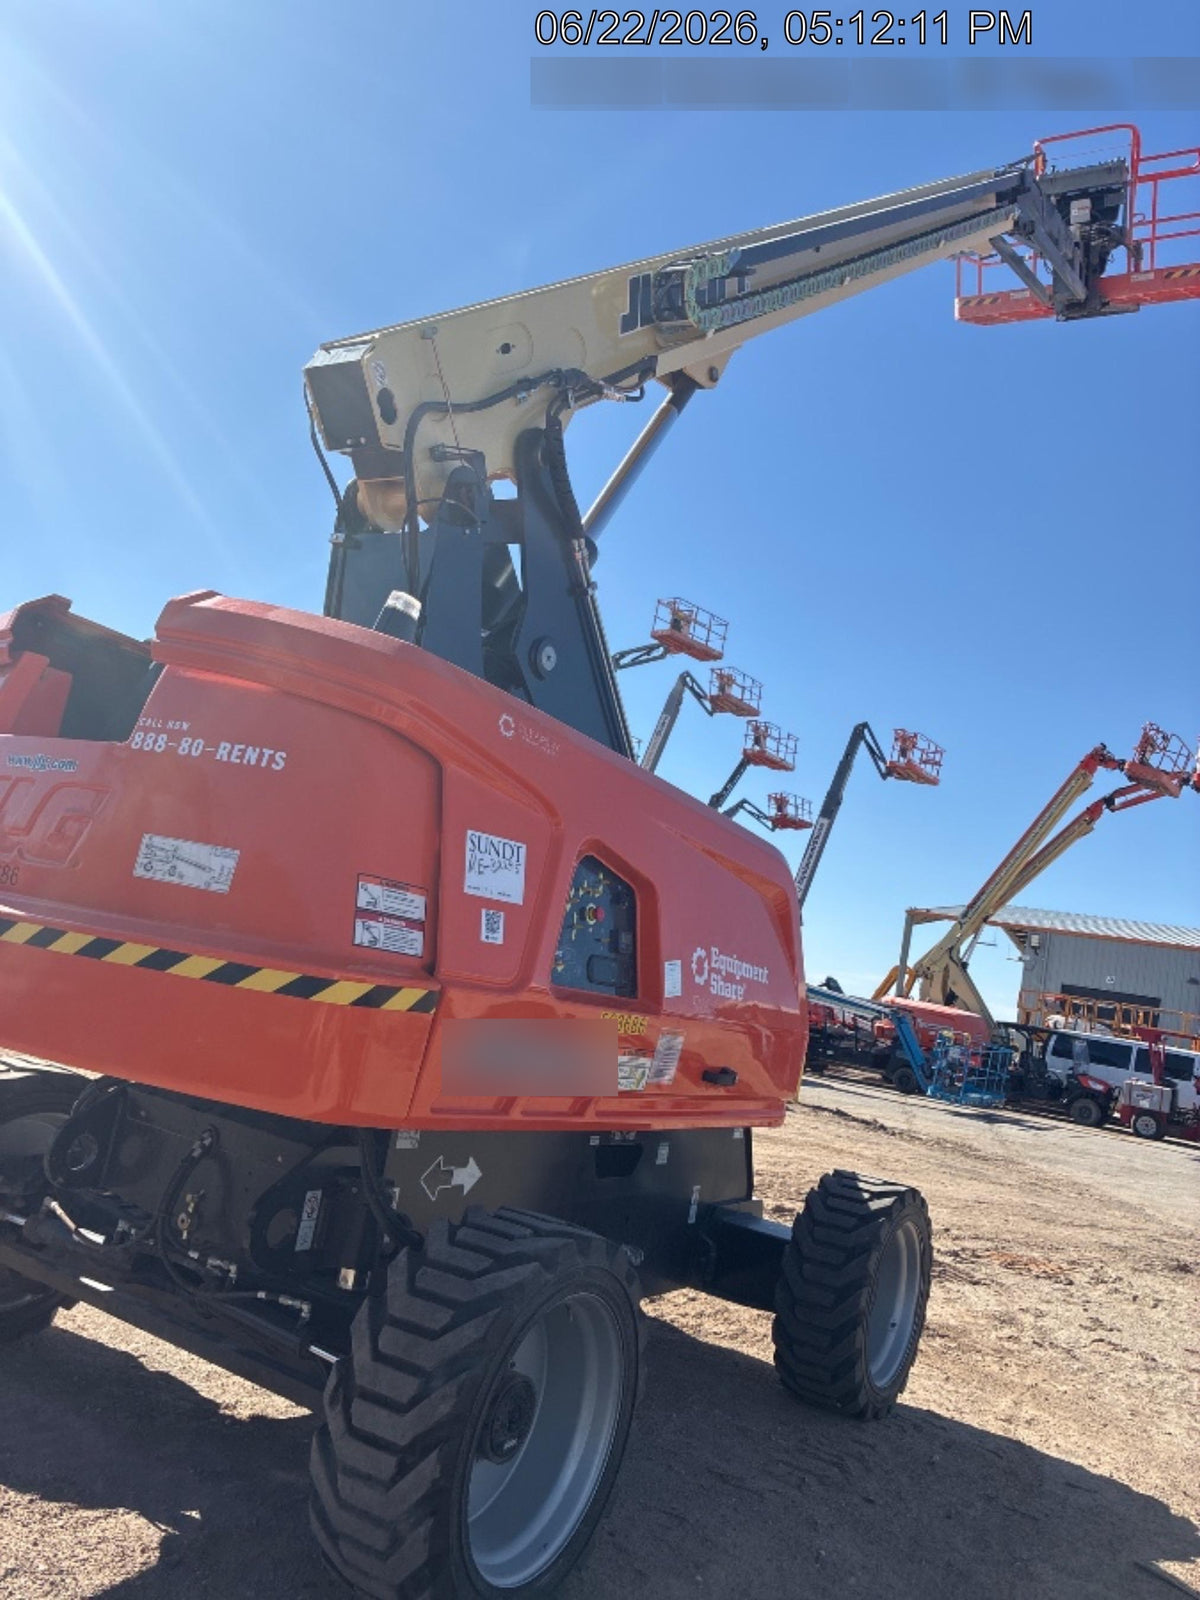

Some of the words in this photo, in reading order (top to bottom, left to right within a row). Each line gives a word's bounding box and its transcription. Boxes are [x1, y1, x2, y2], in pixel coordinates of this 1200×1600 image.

[130, 731, 288, 771] 888-80-RENTS
[468, 832, 524, 864] SUNDT
[710, 946, 769, 985] Equipment
[709, 972, 745, 1002] Share
